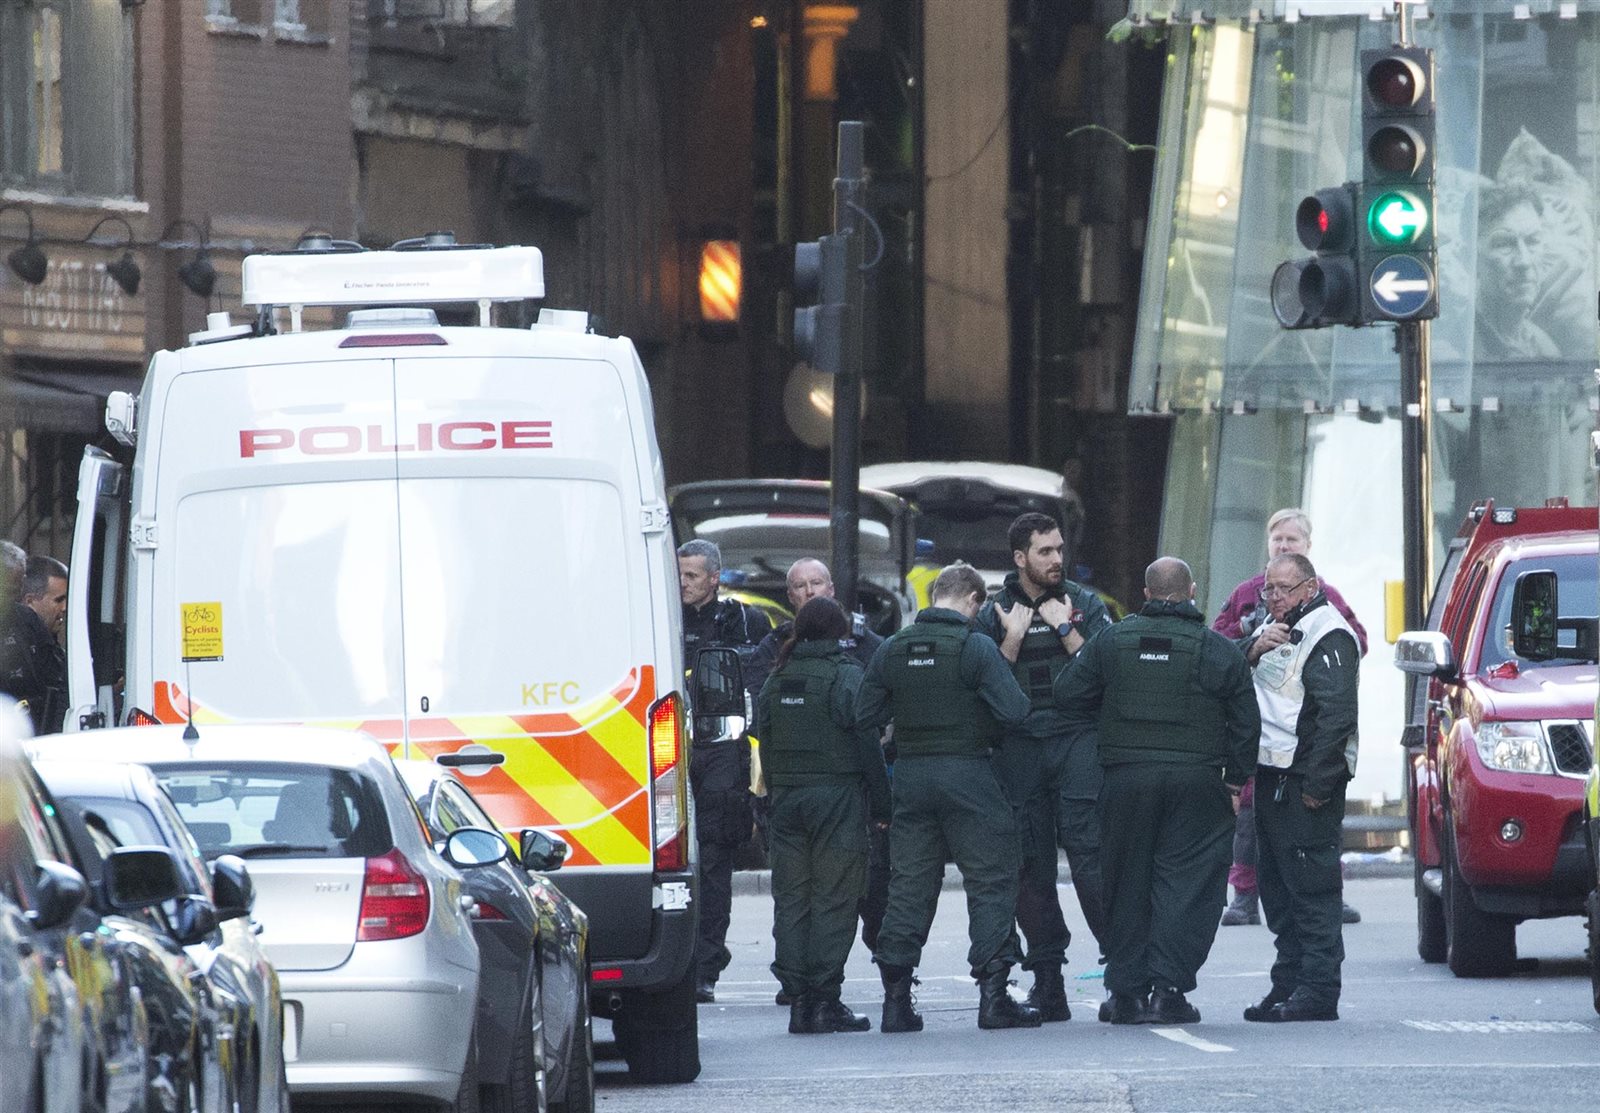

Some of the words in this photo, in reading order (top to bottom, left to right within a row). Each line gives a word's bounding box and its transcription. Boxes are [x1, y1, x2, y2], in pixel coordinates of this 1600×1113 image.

[239, 421, 553, 459] POLICE
[185, 625, 219, 635] Cyclists
[908, 658, 935, 666] AMBULANCE
[1139, 653, 1169, 661] AMBULANCE
[522, 680, 580, 706] KFC
